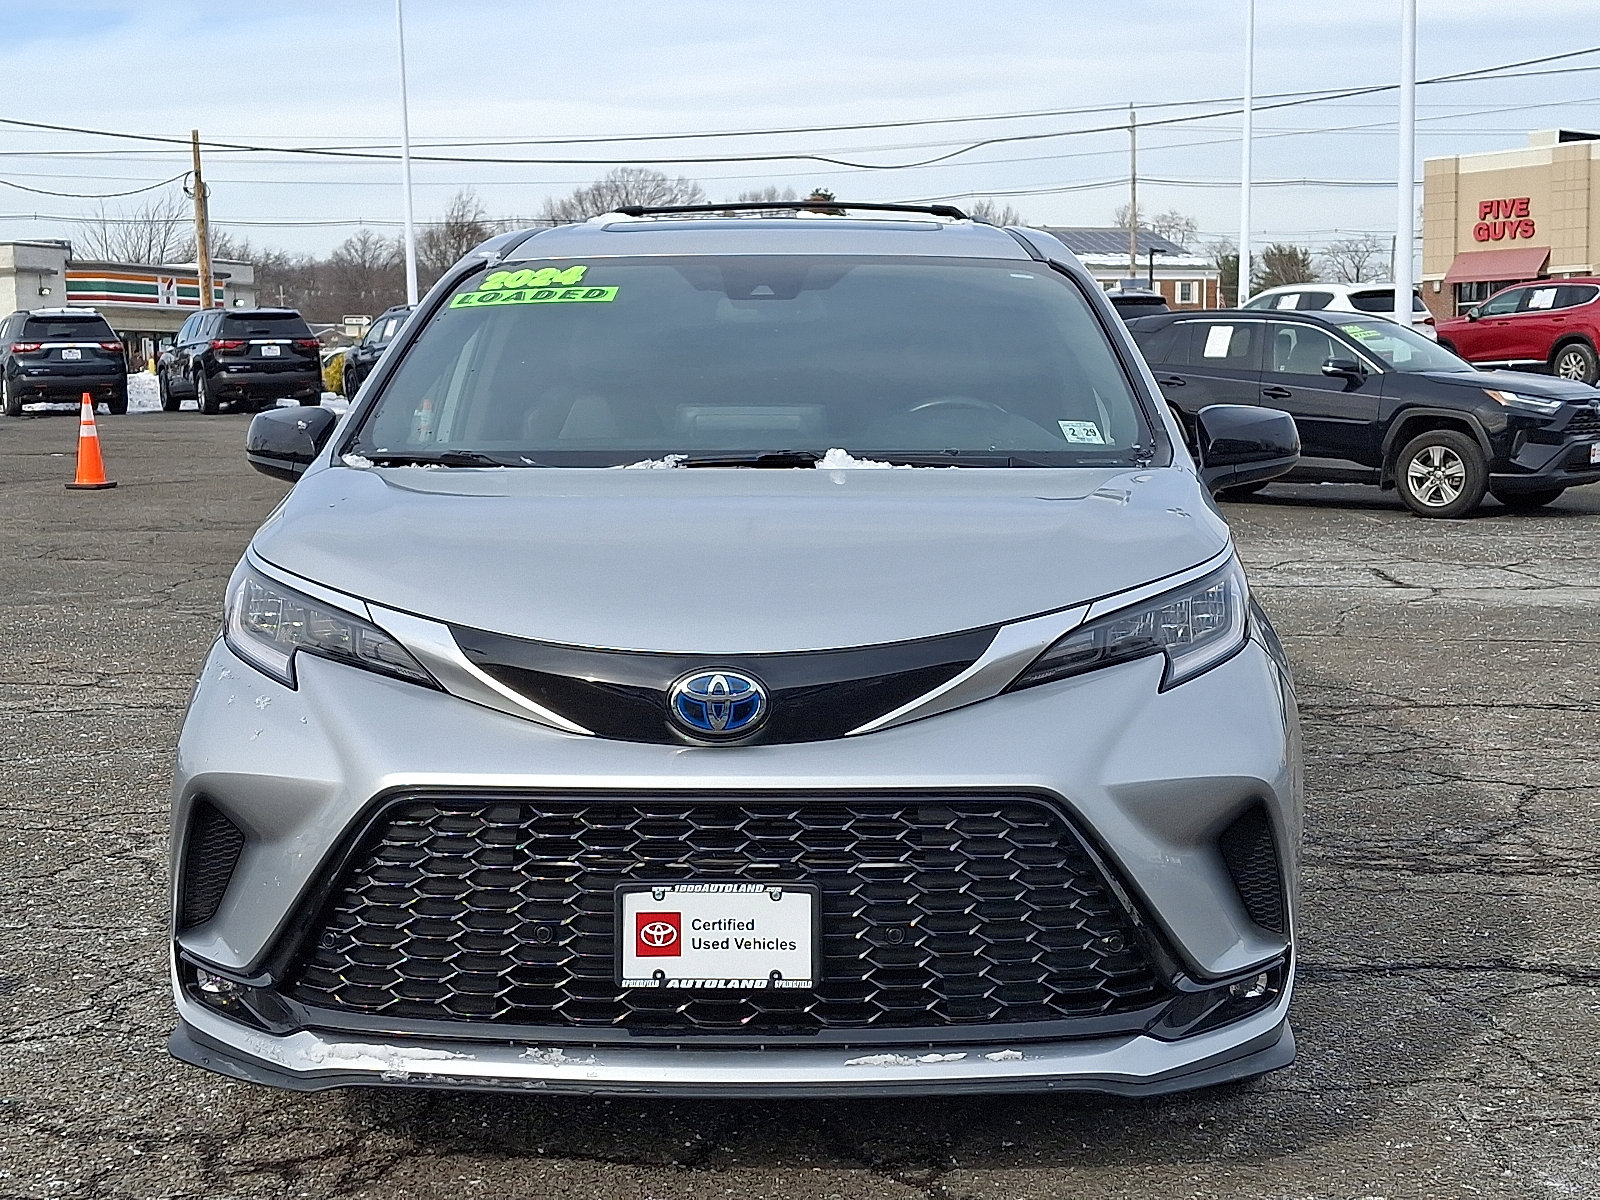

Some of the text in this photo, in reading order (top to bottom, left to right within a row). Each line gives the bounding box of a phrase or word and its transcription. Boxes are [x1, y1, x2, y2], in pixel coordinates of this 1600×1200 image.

[1479, 197, 1530, 220] FIVE
[1473, 219, 1535, 242] GUYS
[479, 265, 587, 290] 2024
[456, 288, 609, 305] LOADED
[1069, 428, 1096, 436] 2 29
[691, 918, 755, 931] Certified
[691, 937, 797, 950] Used Vehicles
[666, 979, 768, 989] AUTOLAND
